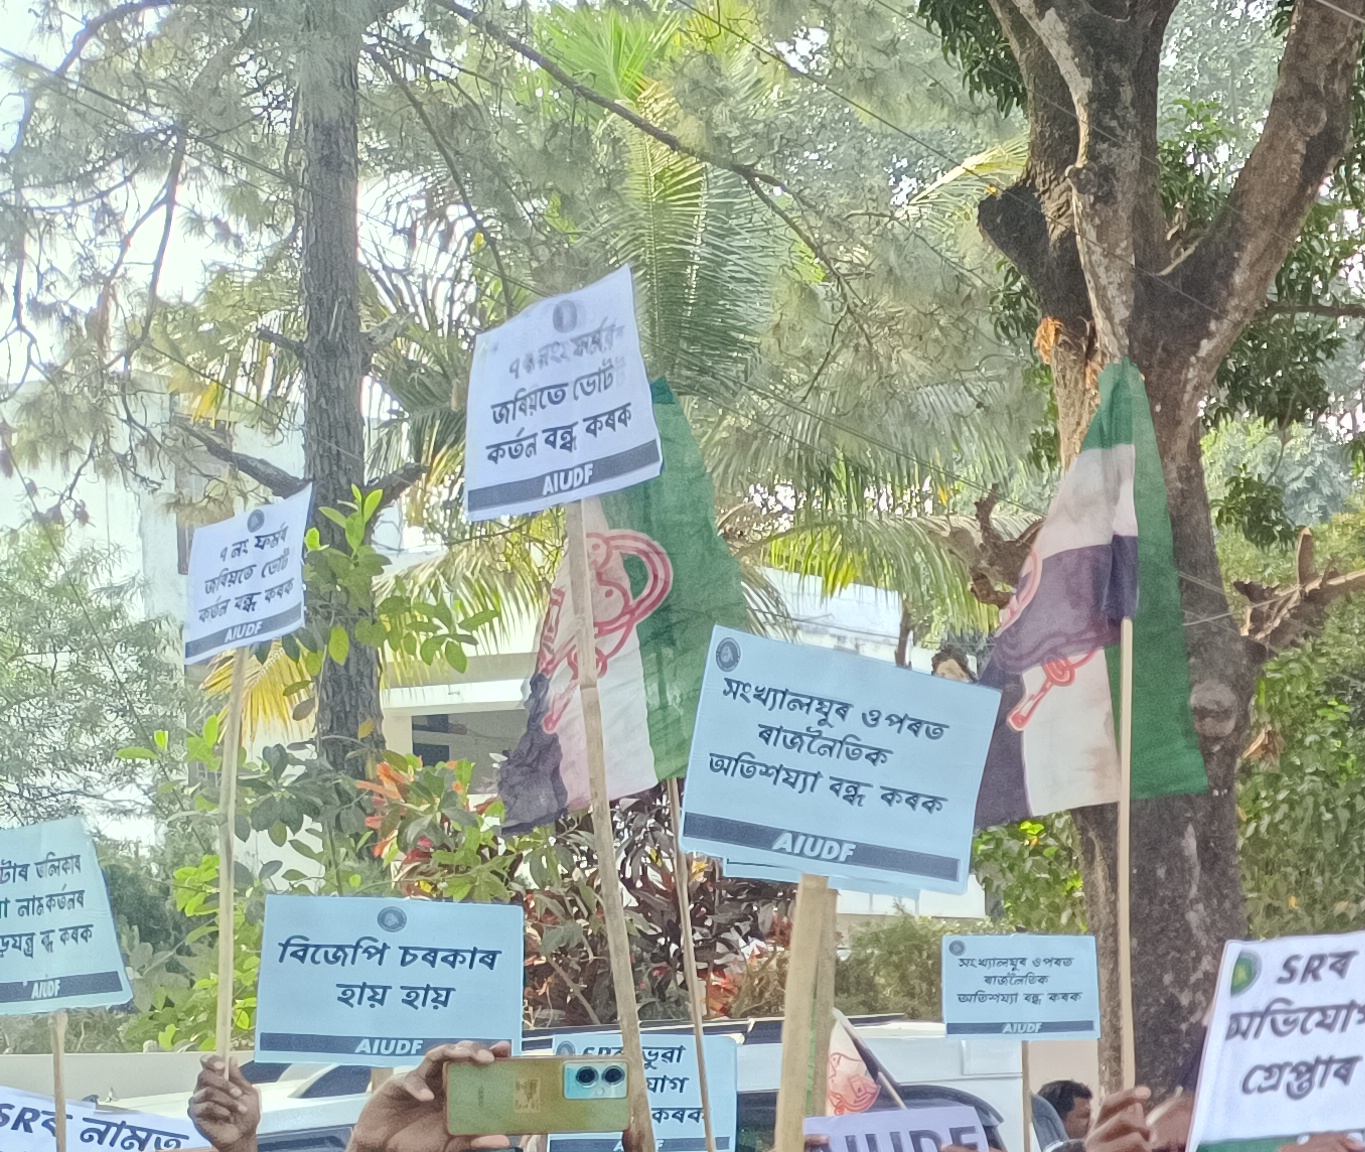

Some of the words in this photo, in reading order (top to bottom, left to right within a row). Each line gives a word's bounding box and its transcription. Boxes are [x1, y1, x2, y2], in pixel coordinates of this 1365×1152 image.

[542, 463, 593, 495] AIUDF
[224, 621, 263, 643] AIUDF
[861, 708, 949, 741] ওপৰত
[758, 723, 893, 767] ৰাজনৈতিক
[829, 775, 873, 808] বন্ধ
[880, 785, 948, 814] কৰক
[772, 832, 856, 861] AIUDF
[277, 934, 392, 969] বিজেপি
[399, 944, 502, 971] চৰকাৰ
[1032, 957, 1074, 968] ওপৰত
[31, 980, 60, 1000] AIUDF
[984, 972, 1050, 986] ৰাজনৈতিক
[335, 982, 392, 1009] হায়
[400, 982, 455, 1011] হায়
[1048, 992, 1082, 1002] কৰক
[1002, 1023, 1042, 1034] AIUDF
[355, 1038, 424, 1055] AIUDF
